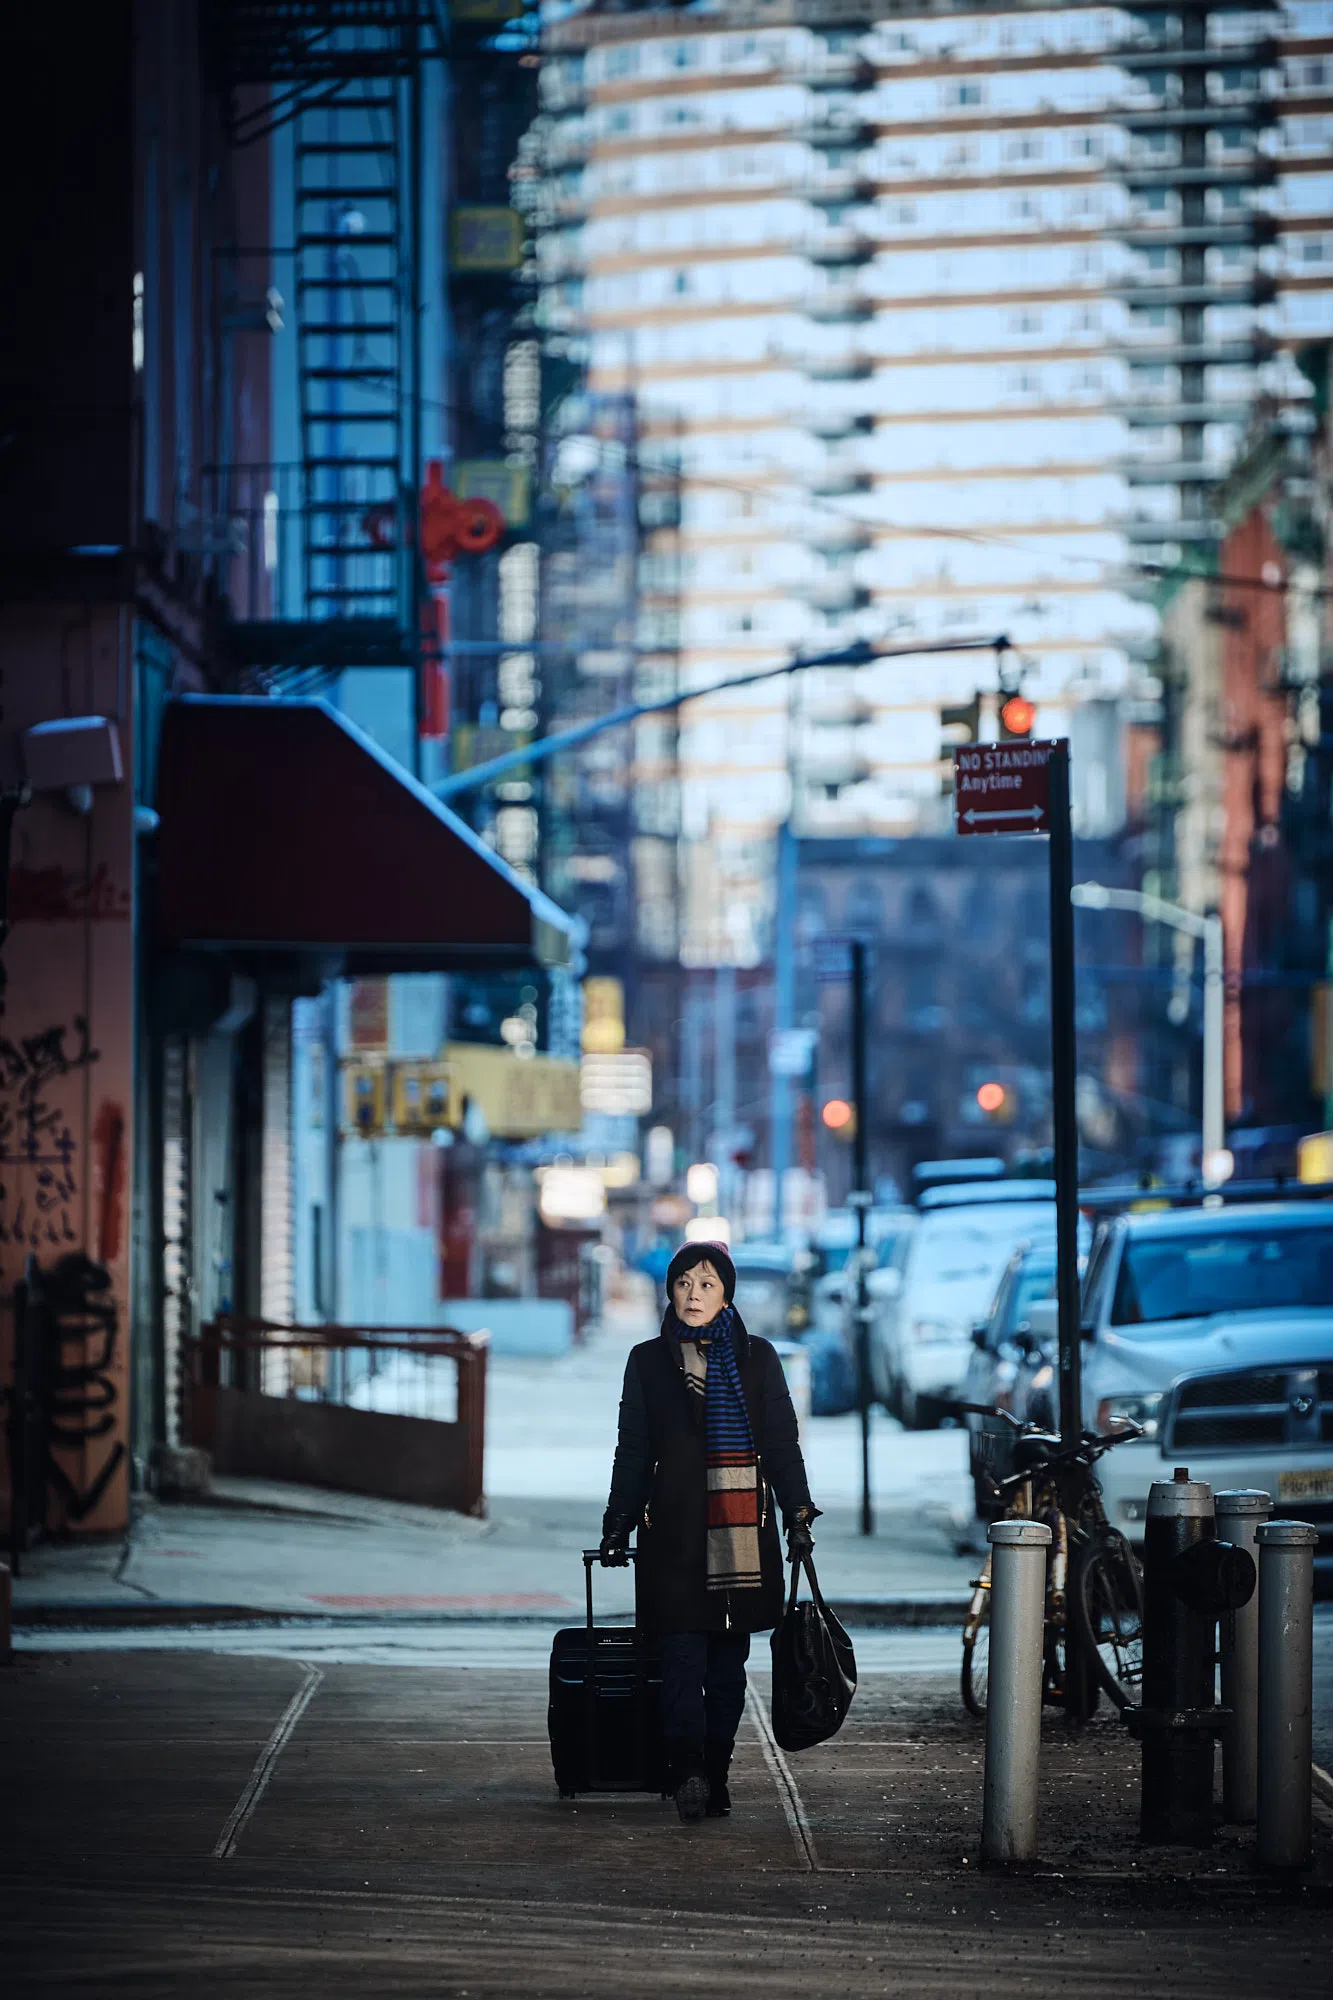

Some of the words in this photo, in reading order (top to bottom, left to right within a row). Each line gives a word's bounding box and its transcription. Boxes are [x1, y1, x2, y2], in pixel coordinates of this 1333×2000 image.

[961, 753, 981, 770] NO
[985, 749, 1053, 769] STANDIN
[962, 773, 1021, 793] Anytime
